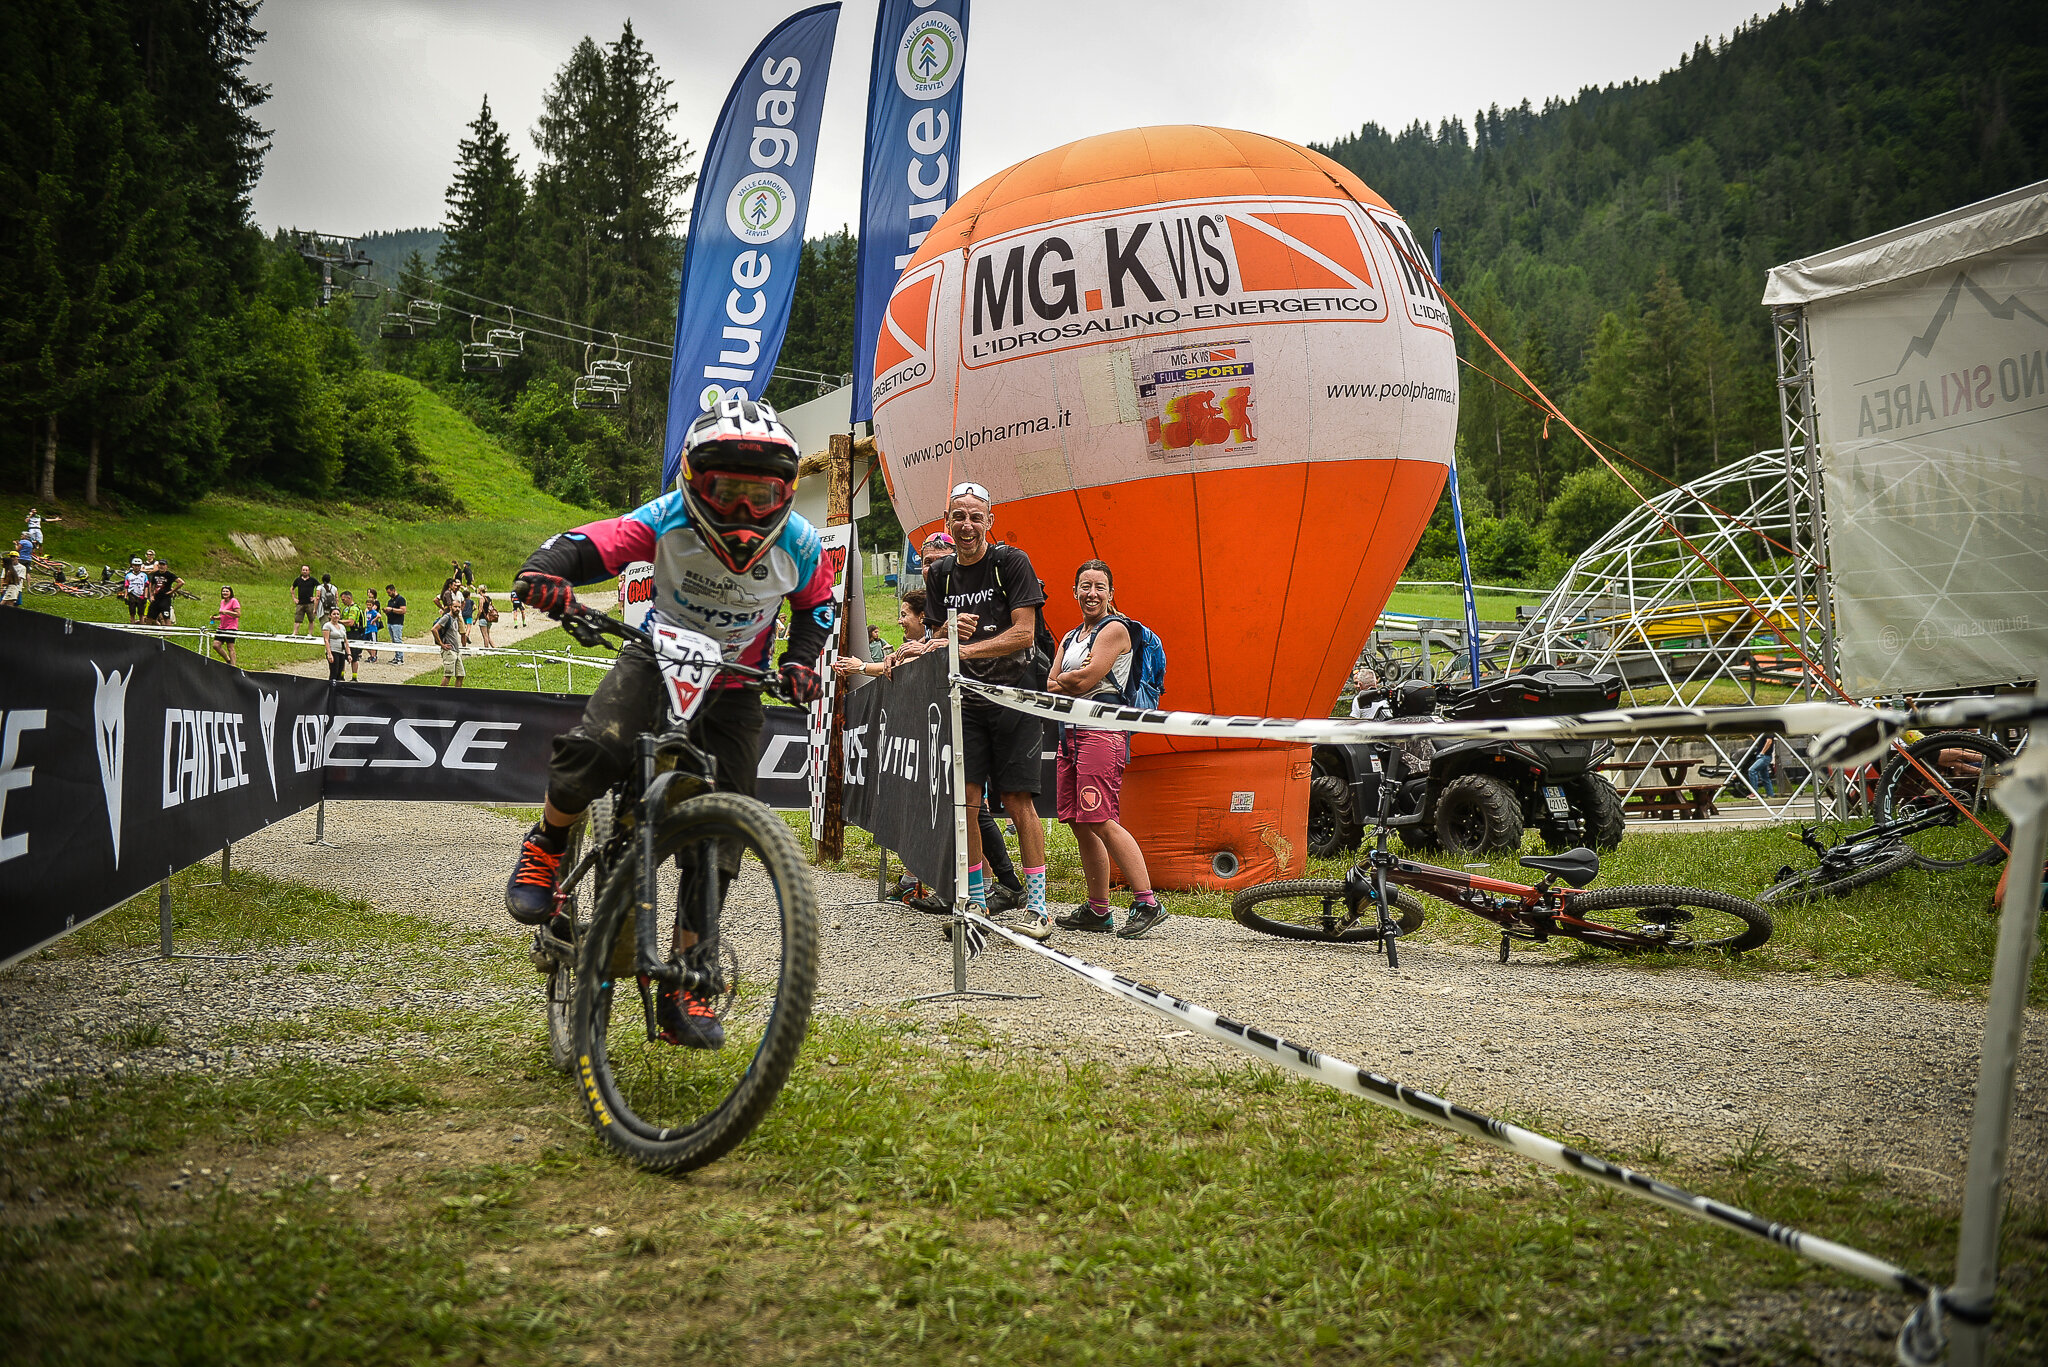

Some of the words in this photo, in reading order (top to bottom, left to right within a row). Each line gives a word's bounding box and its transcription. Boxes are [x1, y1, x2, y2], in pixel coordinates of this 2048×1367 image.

[903, 26, 921, 50] VALLE
[921, 19, 958, 43] CAMONICA
[750, 56, 801, 169] gas
[914, 80, 945, 92] SERVIZI
[737, 181, 757, 198] VALLE
[757, 179, 787, 202] CAMONICA
[744, 228, 770, 238] SERVIZI
[703, 249, 772, 382] luce
[902, 408, 1072, 469] www.poolpharma.it
[162, 707, 249, 810] DAINESE
[579, 1054, 613, 1127] MAXXIS
